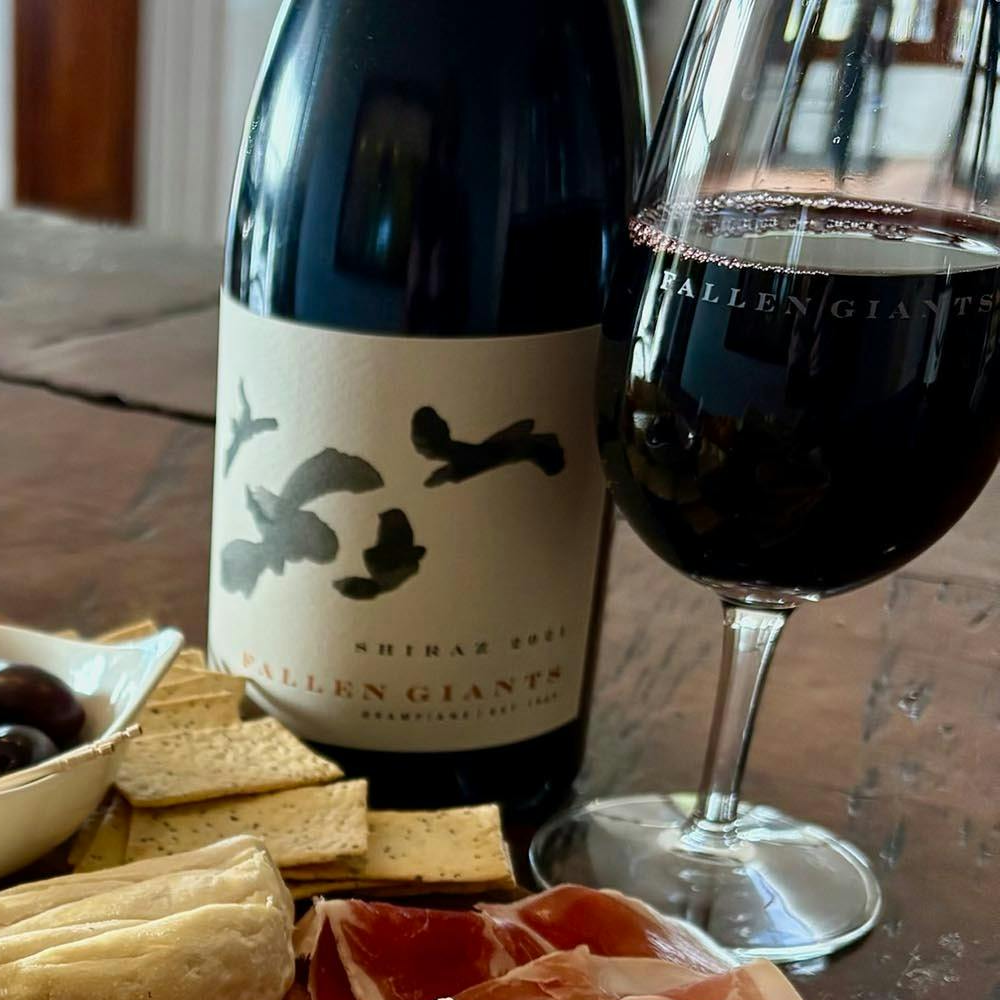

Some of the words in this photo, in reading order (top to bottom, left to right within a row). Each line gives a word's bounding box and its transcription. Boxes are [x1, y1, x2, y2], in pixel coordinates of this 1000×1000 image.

[659, 269, 812, 316] FALLEN
[355, 642, 488, 657] SHIRAZ
[242, 651, 387, 702] FALLEN
[405, 664, 563, 704] GIANTS
